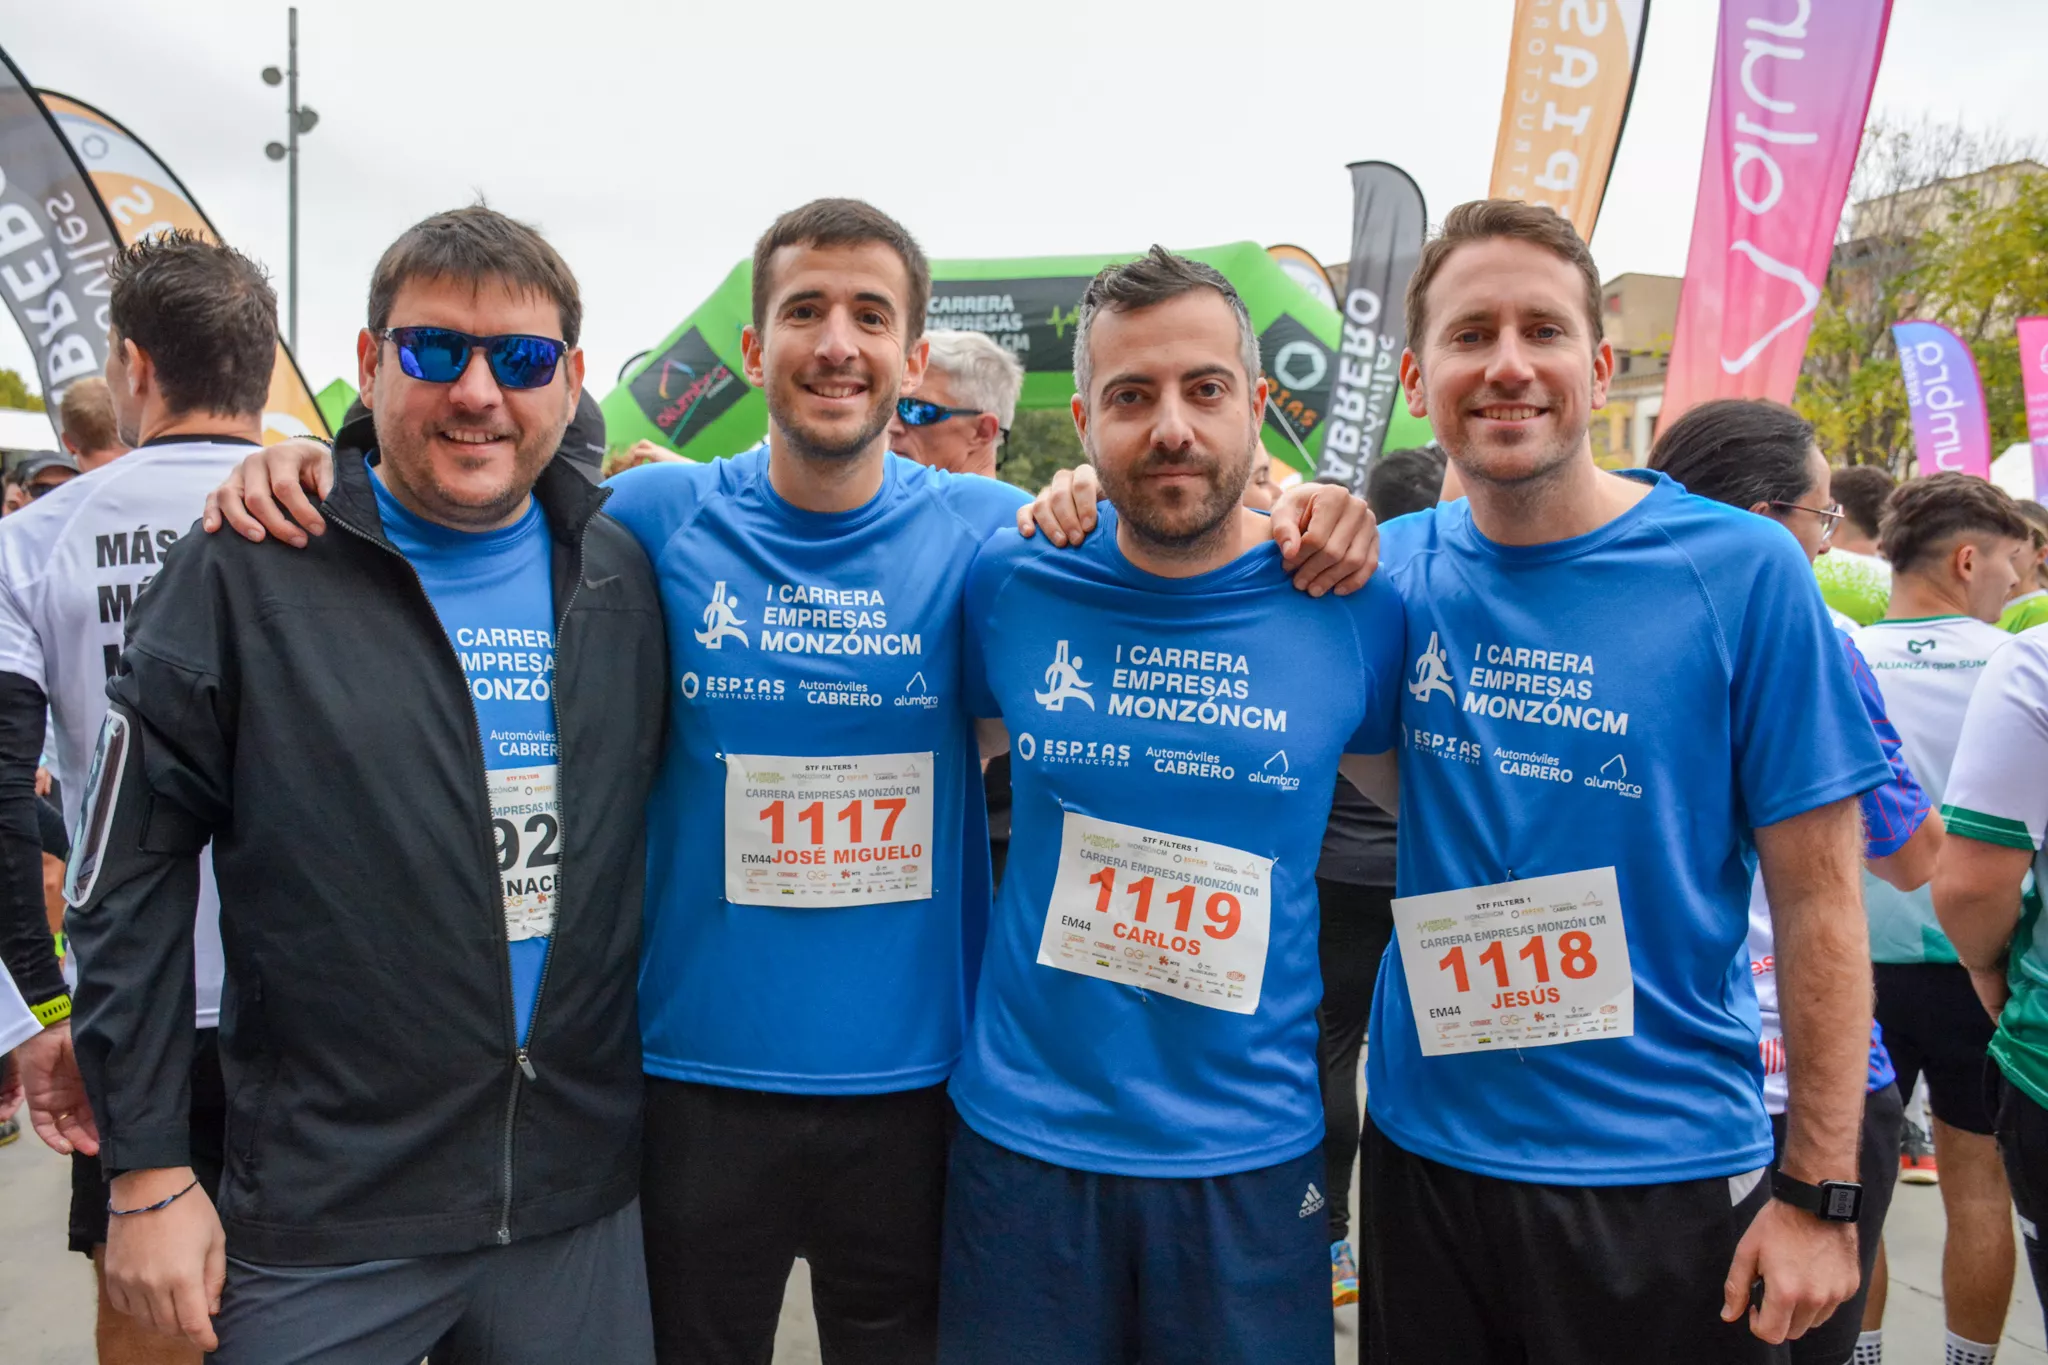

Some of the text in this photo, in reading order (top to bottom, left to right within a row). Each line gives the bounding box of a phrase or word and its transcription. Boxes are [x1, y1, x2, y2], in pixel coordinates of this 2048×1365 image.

[927, 293, 1015, 315] CARRERA
[95, 524, 179, 568] MÁS
[778, 584, 885, 606] CARRERA
[763, 606, 887, 629] EMPRESAS
[456, 627, 556, 649] CARRER
[760, 629, 922, 656] MONZÓNCM
[1129, 645, 1250, 675] CARRERA
[1486, 644, 1595, 676] CARRERA
[1875, 660, 1930, 671] ALIANZA
[1931, 662, 1957, 672] que
[465, 672, 557, 702] ONZÓ
[705, 676, 786, 695] ESPIAS
[798, 679, 868, 693] Automóviles
[1112, 668, 1250, 700] EMPRESAS
[1469, 667, 1593, 700] EMPRESAS
[705, 692, 785, 701] CONSTRUCTORA
[806, 691, 883, 707] CABRERO
[1107, 693, 1288, 732] MONZÓNCM
[1462, 691, 1629, 736] MONZÓNCM
[489, 729, 557, 742] Automóviles
[1413, 729, 1482, 759] ESPIAS
[1043, 739, 1132, 761] ESPIAS
[1145, 746, 1221, 764] Automóviles
[1493, 746, 1560, 766] Automóviles
[804, 764, 820, 772] STF
[821, 763, 853, 771] FILTERS
[1042, 755, 1130, 768] CONSTRUCTORA
[1153, 759, 1236, 780] CABRERO
[1499, 760, 1574, 784] CABRERO
[1248, 771, 1300, 787] alumbra
[1583, 774, 1643, 795] alumbra
[745, 784, 921, 800] CARRERA EMPRESAS MONZÓN CM
[759, 798, 907, 845] 1117
[1141, 835, 1158, 845] STF
[1158, 839, 1192, 852] FILTERS
[741, 853, 772, 865] EM44
[772, 846, 826, 865] JOSÉ
[1079, 848, 1128, 869] CARRERA
[1130, 861, 1192, 883] EMPRESAS
[1193, 874, 1241, 894] MONZÓN
[1243, 884, 1259, 897] CM
[1088, 865, 1242, 941] 1119
[1475, 902, 1492, 911] STF
[1492, 897, 1526, 909] FILTERS
[1061, 914, 1092, 932] EM44
[1420, 929, 1473, 950] CARRERA
[1474, 924, 1535, 943] EMPRESAS
[1537, 916, 1587, 934] MONZÓN
[1588, 914, 1607, 927] CM
[1112, 921, 1201, 956] CARLOS
[1438, 930, 1598, 993] 1118
[1490, 984, 1561, 1010] JESÚS
[1429, 1005, 1462, 1019] EM44
